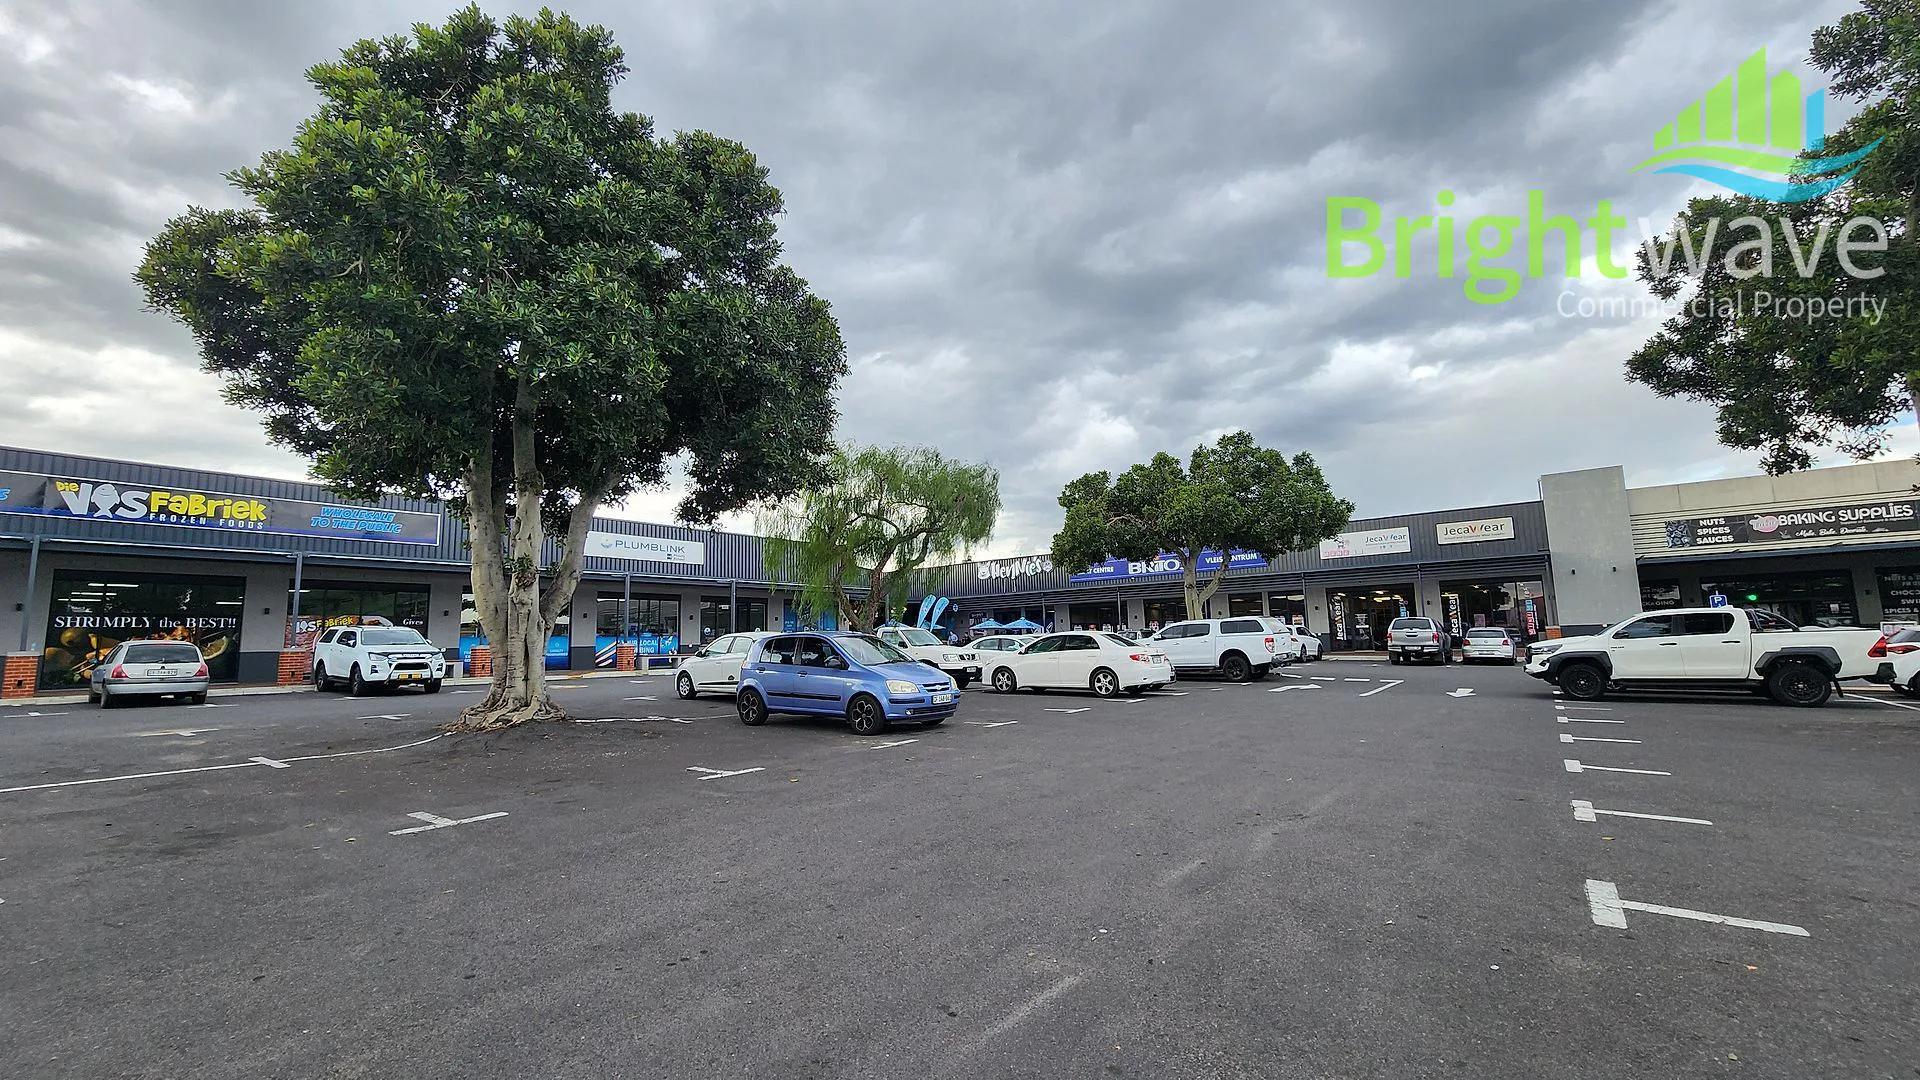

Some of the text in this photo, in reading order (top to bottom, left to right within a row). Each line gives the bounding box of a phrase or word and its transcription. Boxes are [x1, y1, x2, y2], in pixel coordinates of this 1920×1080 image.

[320, 506, 396, 522] WHOLESALE
[1778, 510, 1836, 526] BAKING
[149, 513, 264, 530] FROZEN FOODS
[311, 517, 403, 534] TO THE PUBLIC
[1699, 517, 1726, 527] NUTS
[1696, 526, 1731, 536] SPICES
[615, 539, 685, 554] PLUMBLINK
[1696, 535, 1734, 545] SAUCES
[1093, 566, 1114, 574] CENTRE
[1128, 559, 1185, 575] BRITO
[1714, 596, 1722, 604] P
[54, 615, 237, 628] SHRIMPLY the BEST!!
